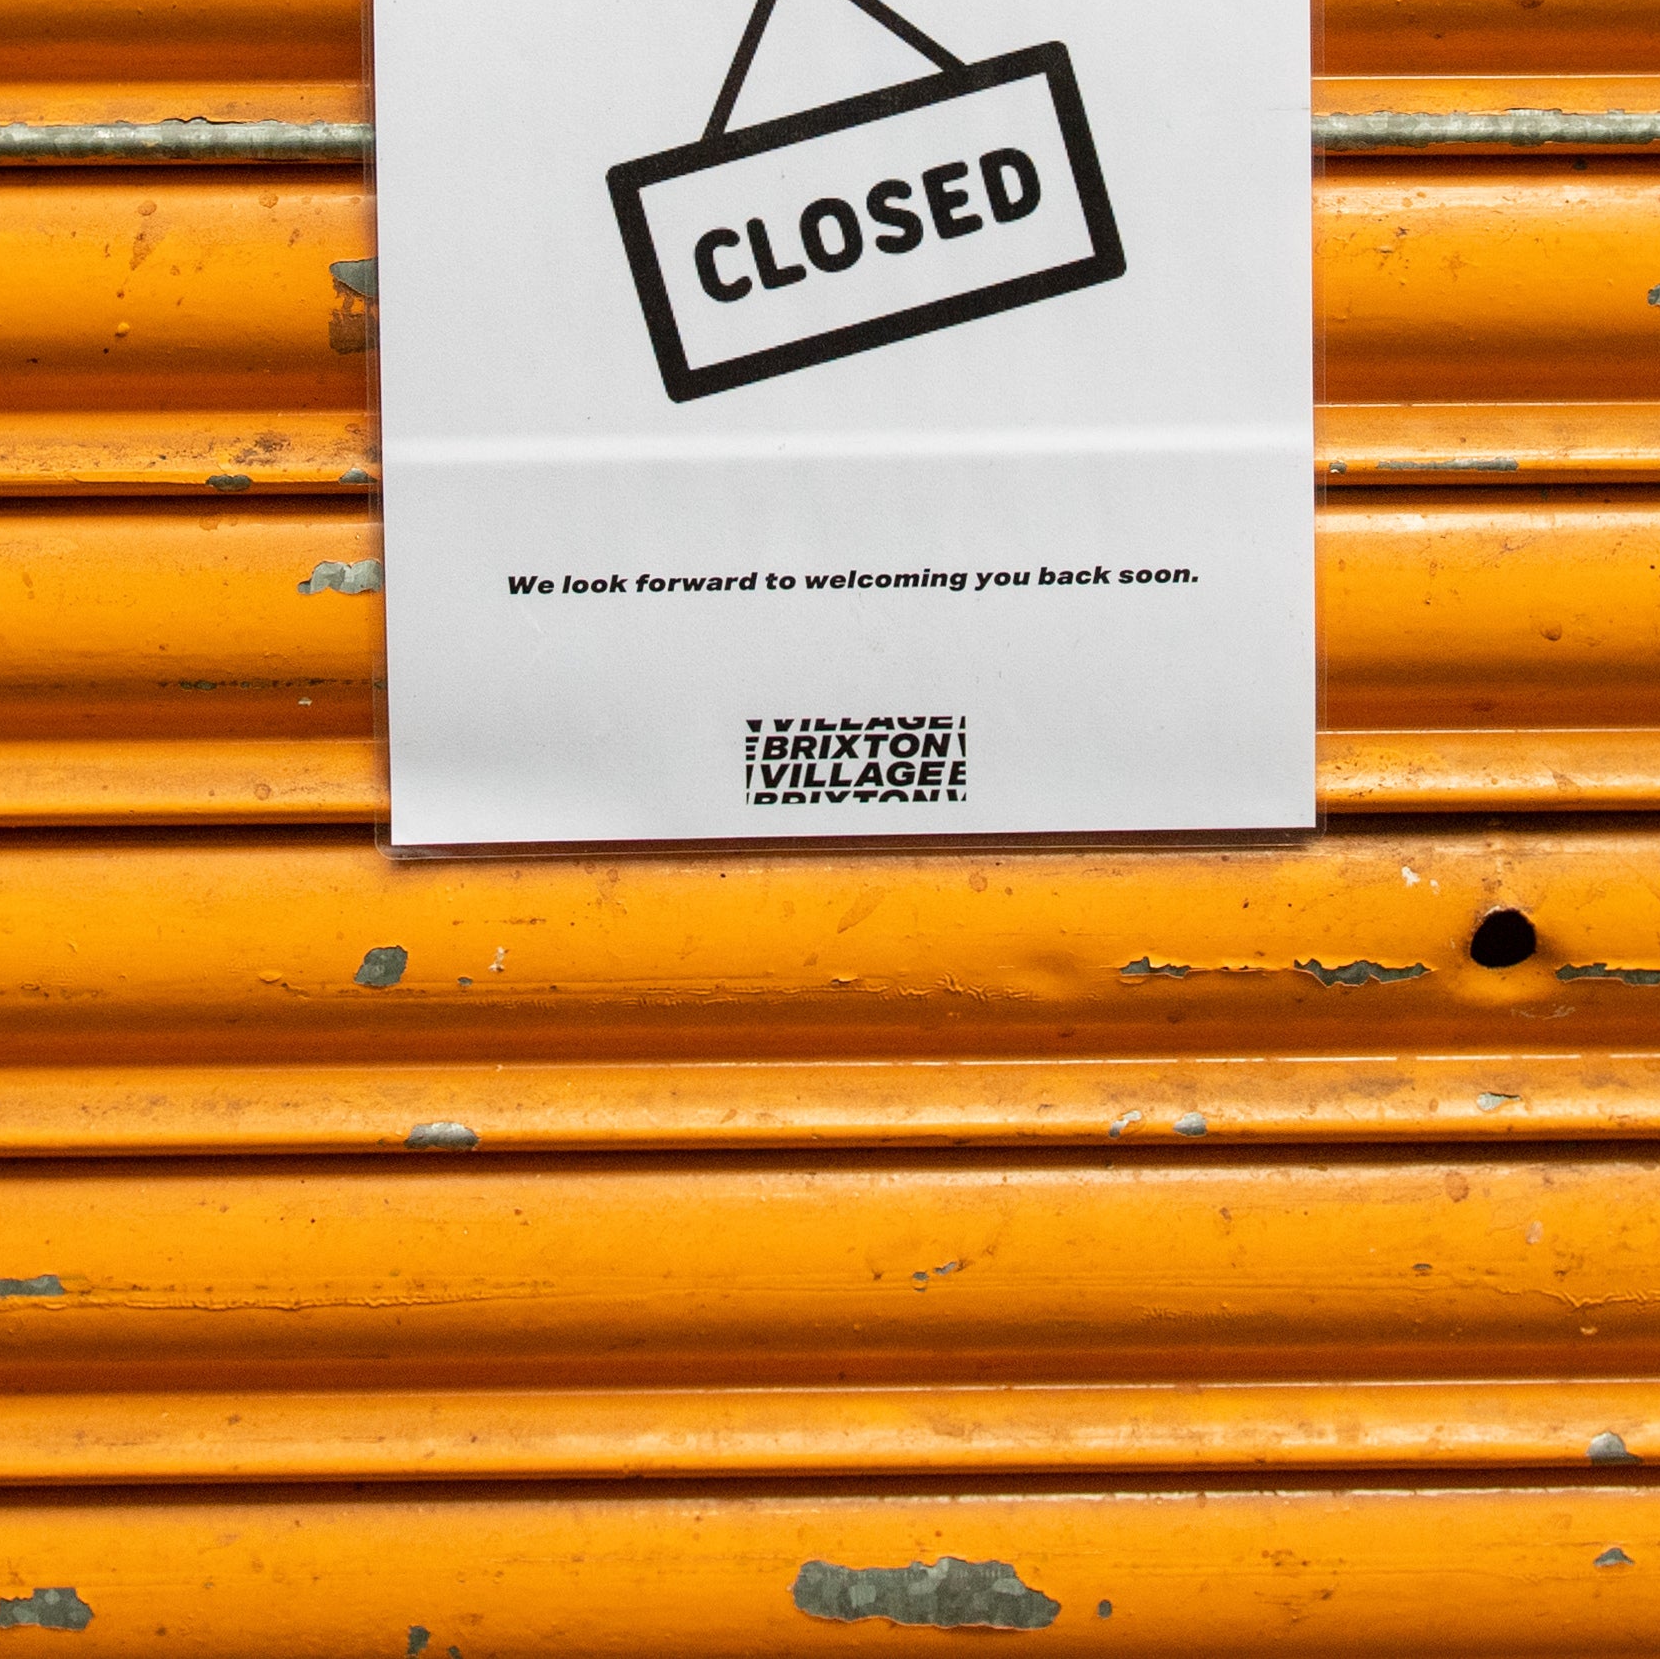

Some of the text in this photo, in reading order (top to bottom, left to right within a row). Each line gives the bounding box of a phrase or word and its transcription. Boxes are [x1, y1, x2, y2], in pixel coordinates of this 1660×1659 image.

[693, 147, 1043, 304] CLOSED
[508, 565, 1200, 595] We look forward to welcoming you back soon.
[762, 733, 950, 760] BRIXTON
[760, 761, 945, 788] VILLAGE
